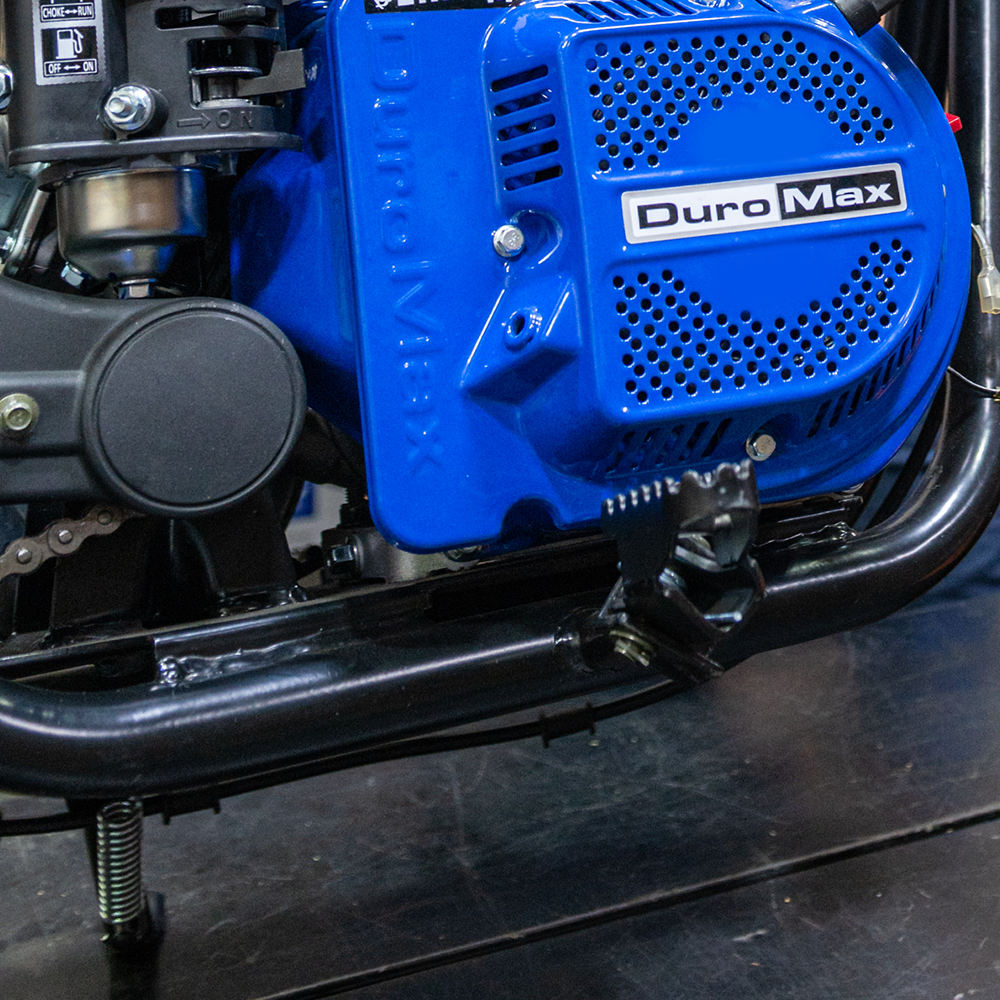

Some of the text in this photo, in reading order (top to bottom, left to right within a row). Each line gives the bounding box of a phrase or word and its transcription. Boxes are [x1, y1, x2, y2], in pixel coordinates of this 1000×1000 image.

[43, 5, 93, 18] CHOKE RUN
[48, 61, 94, 74] OFF ON
[217, 109, 254, 130] ON
